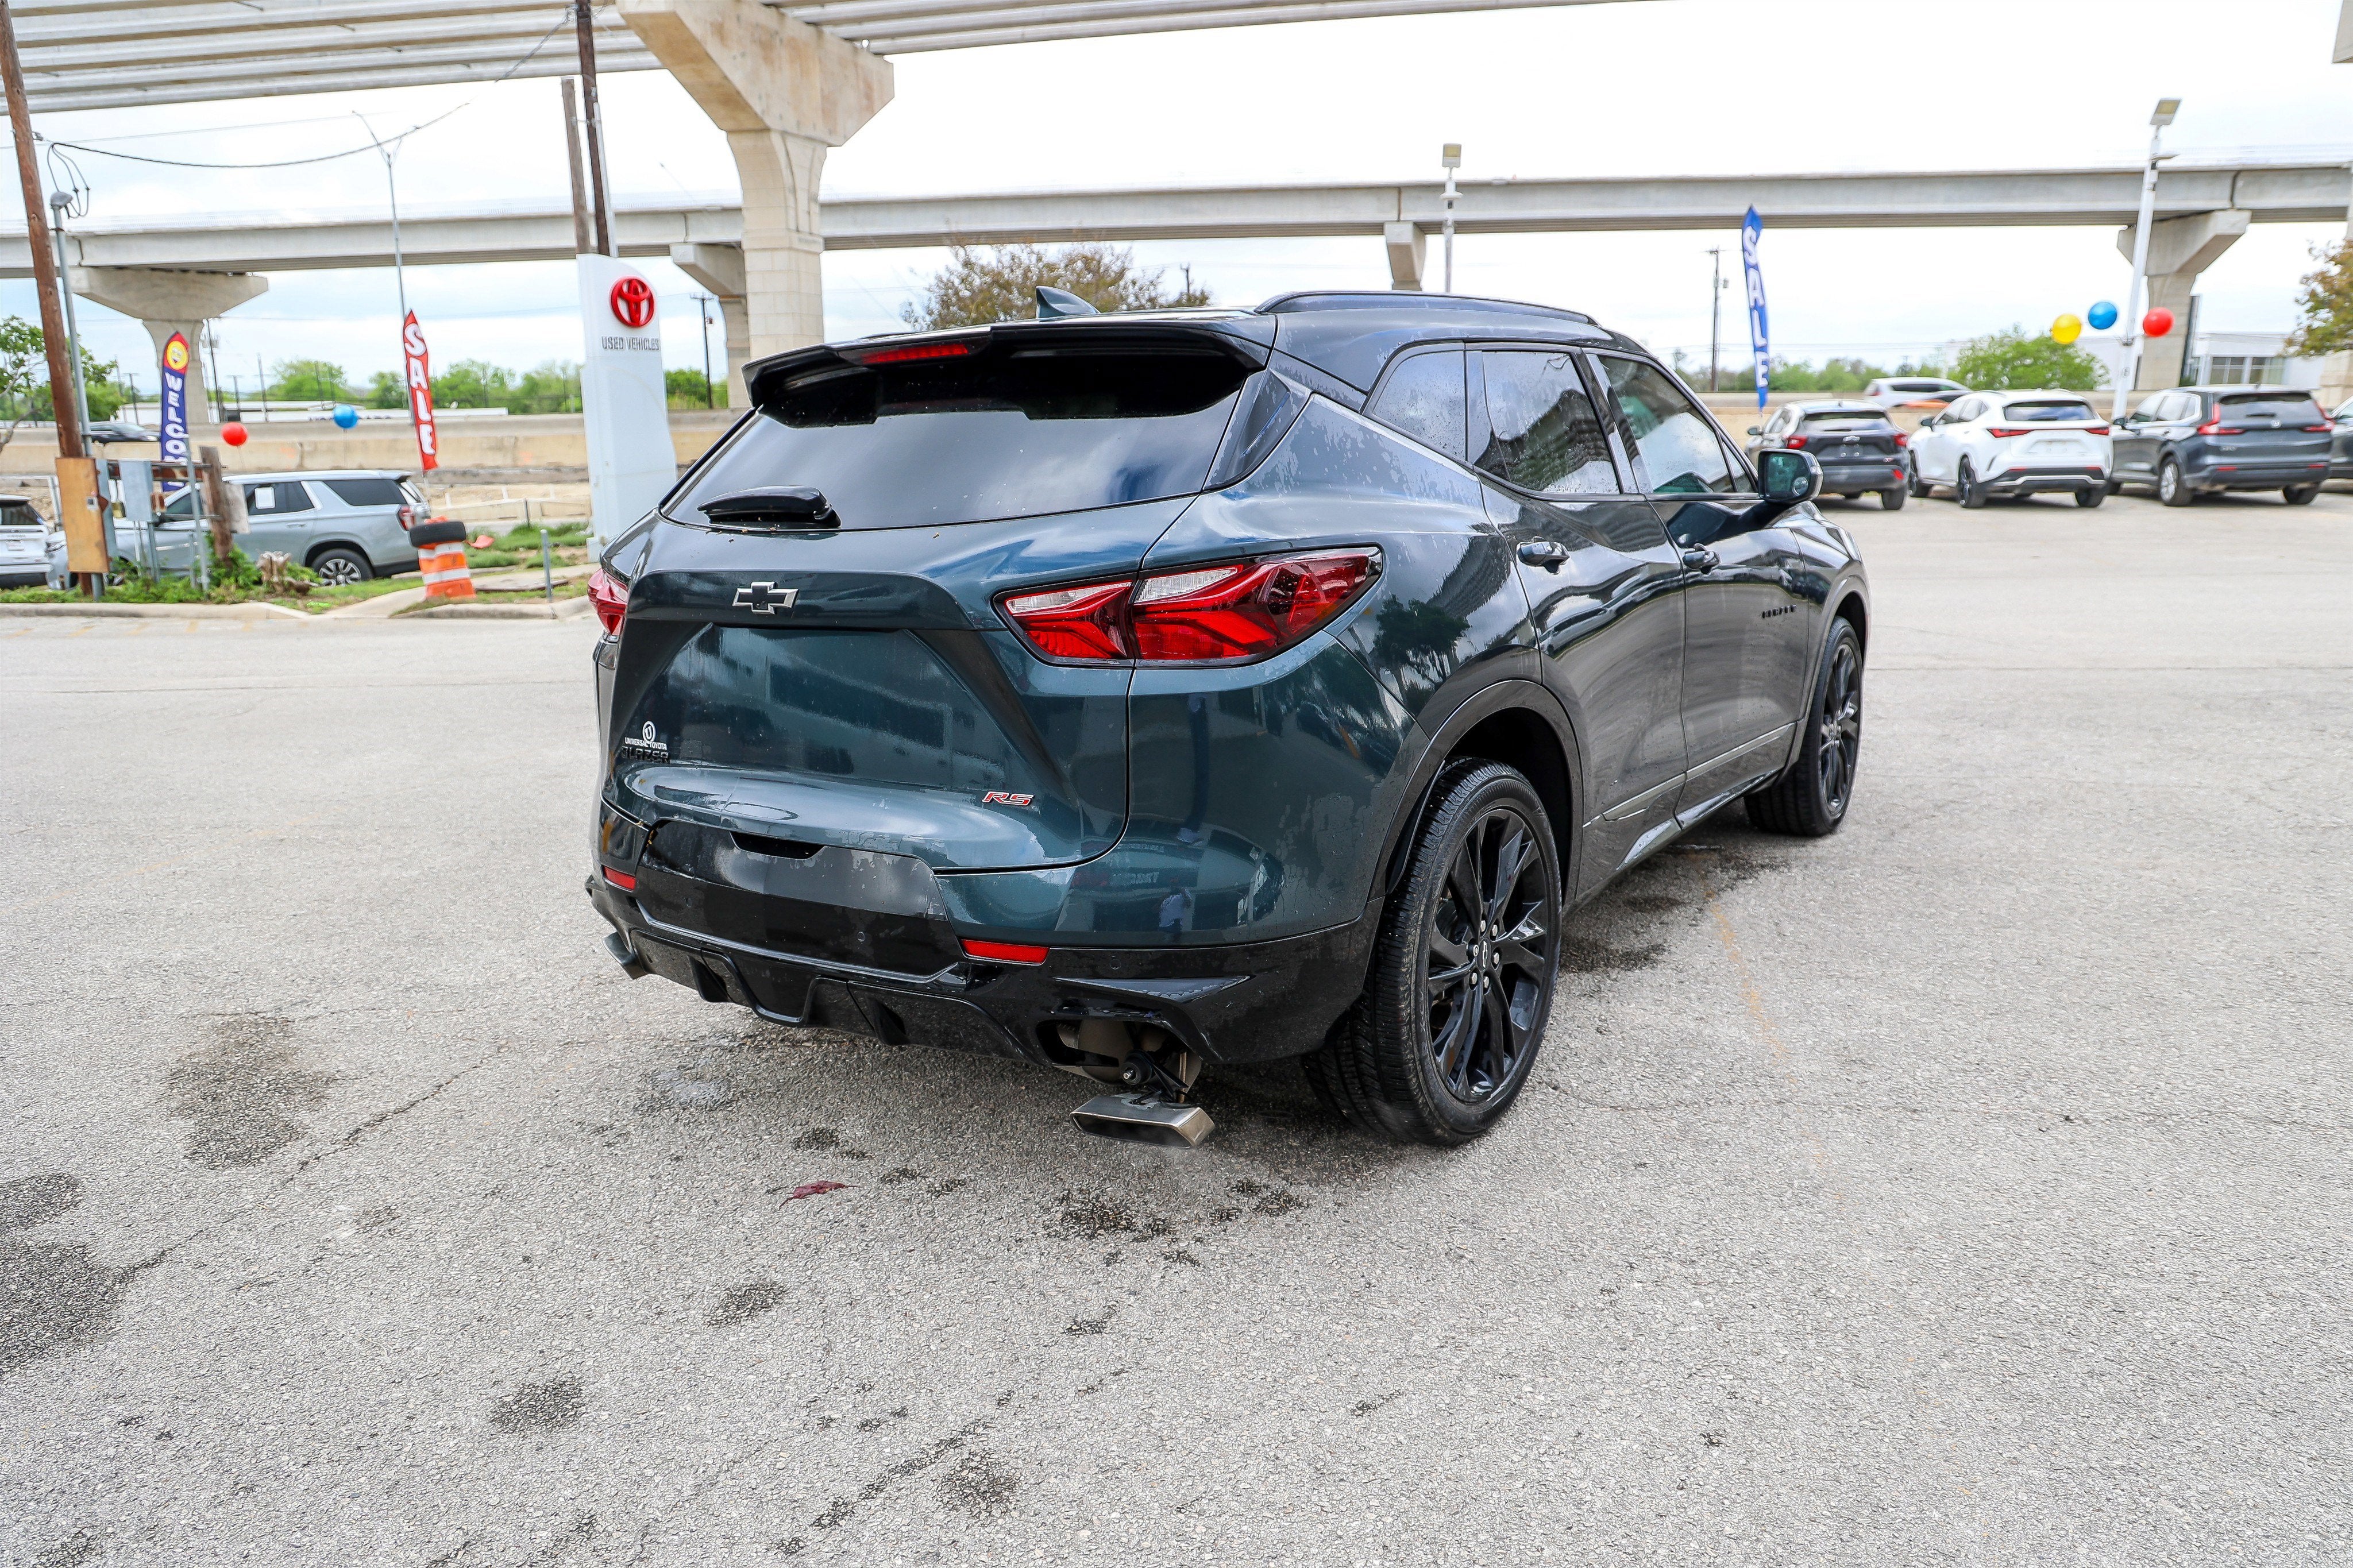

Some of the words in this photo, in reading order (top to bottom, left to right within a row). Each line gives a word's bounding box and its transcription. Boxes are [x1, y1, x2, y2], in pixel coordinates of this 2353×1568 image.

[1743, 226, 1769, 387] SALE
[601, 336, 624, 349] USED
[626, 337, 659, 350] VEHICLES
[404, 323, 436, 454] SALE
[165, 372, 190, 487] WELCO
[624, 737, 649, 747] UNIVERSAL
[649, 741, 668, 750] TOYOTA
[622, 746, 670, 764] BLAZER
[982, 791, 1034, 806] RS
